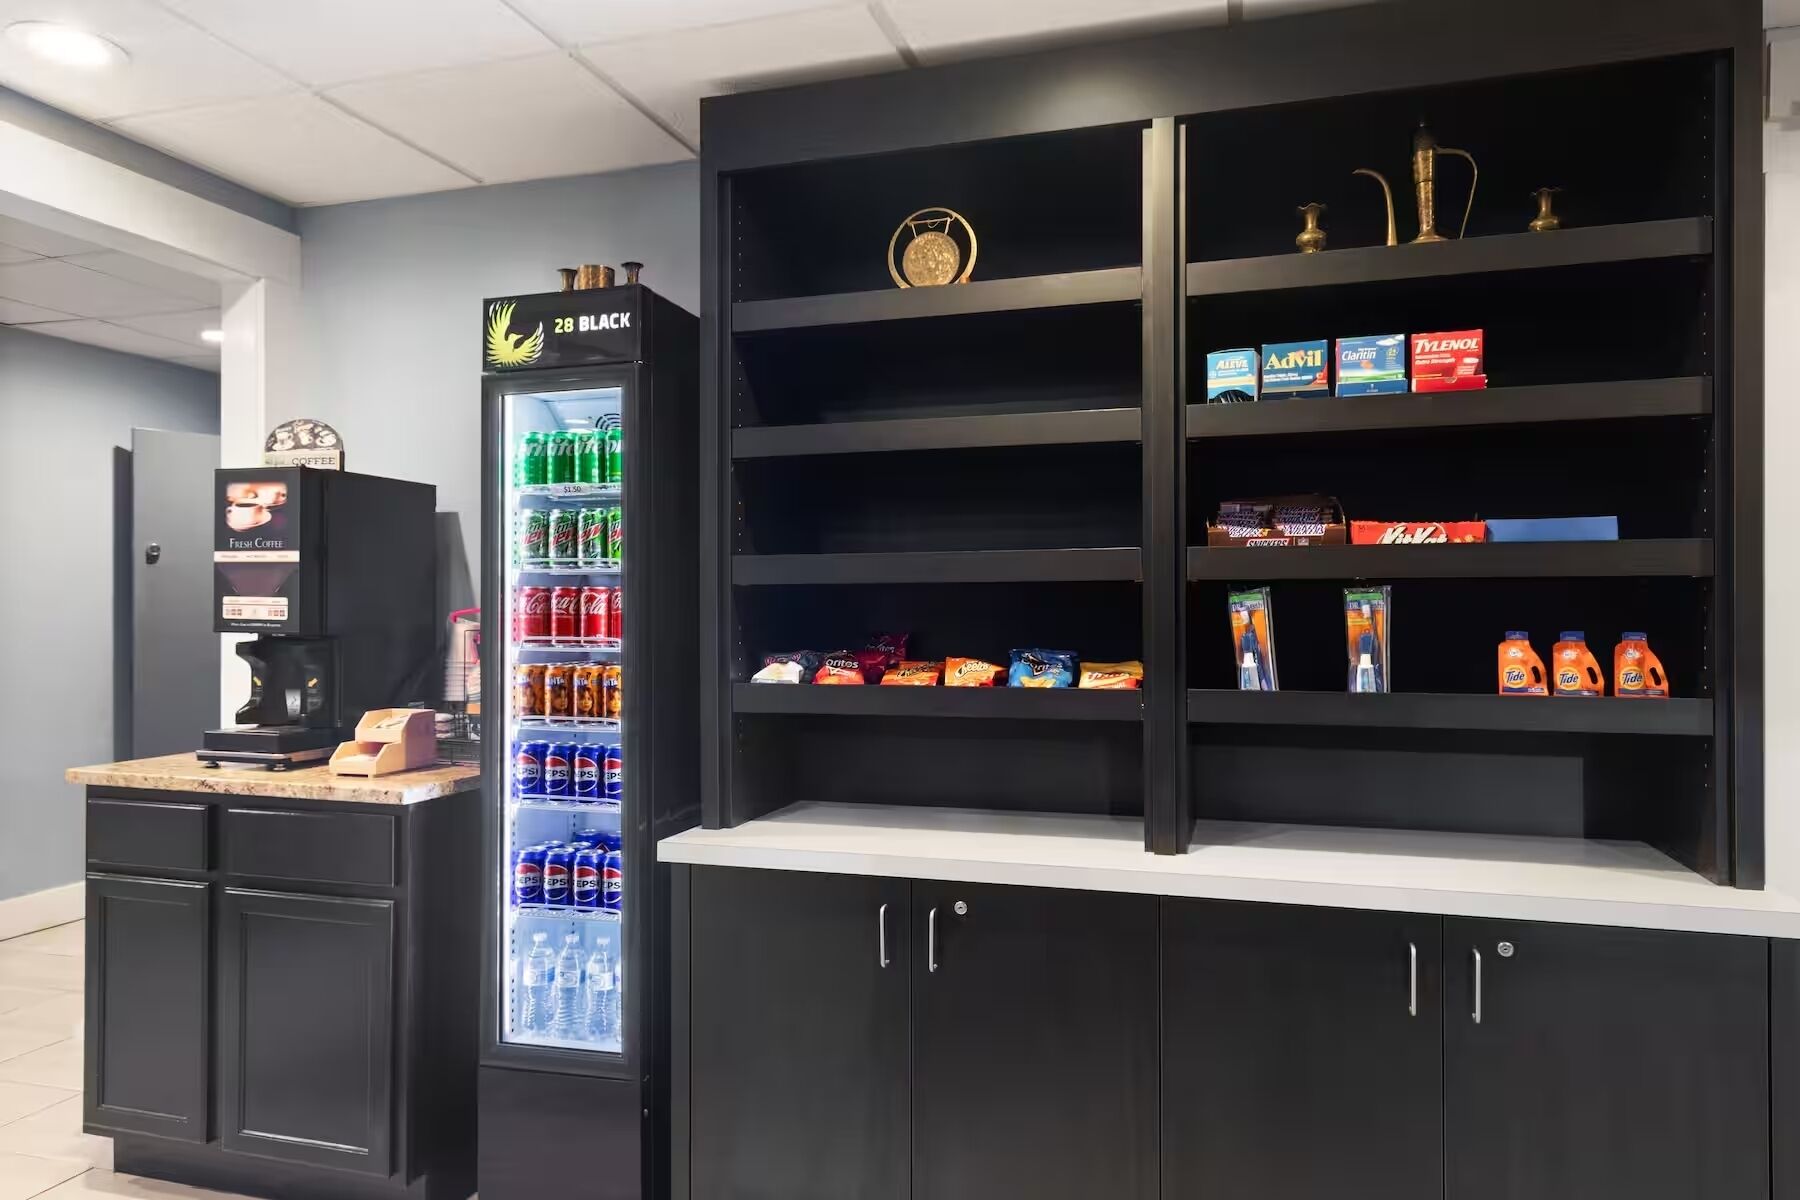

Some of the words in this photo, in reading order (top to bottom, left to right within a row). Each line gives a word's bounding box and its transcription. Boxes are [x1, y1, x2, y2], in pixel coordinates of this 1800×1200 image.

[554, 317, 574, 334] 28
[579, 312, 631, 332] BLACK
[1414, 338, 1479, 354] TYLENOL
[1342, 348, 1377, 361] Claritin
[292, 457, 335, 466] COFFEE
[825, 658, 859, 669] oritos
[1506, 670, 1525, 683] Tide
[1560, 673, 1579, 685] Tide
[1622, 673, 1642, 686] Tide
